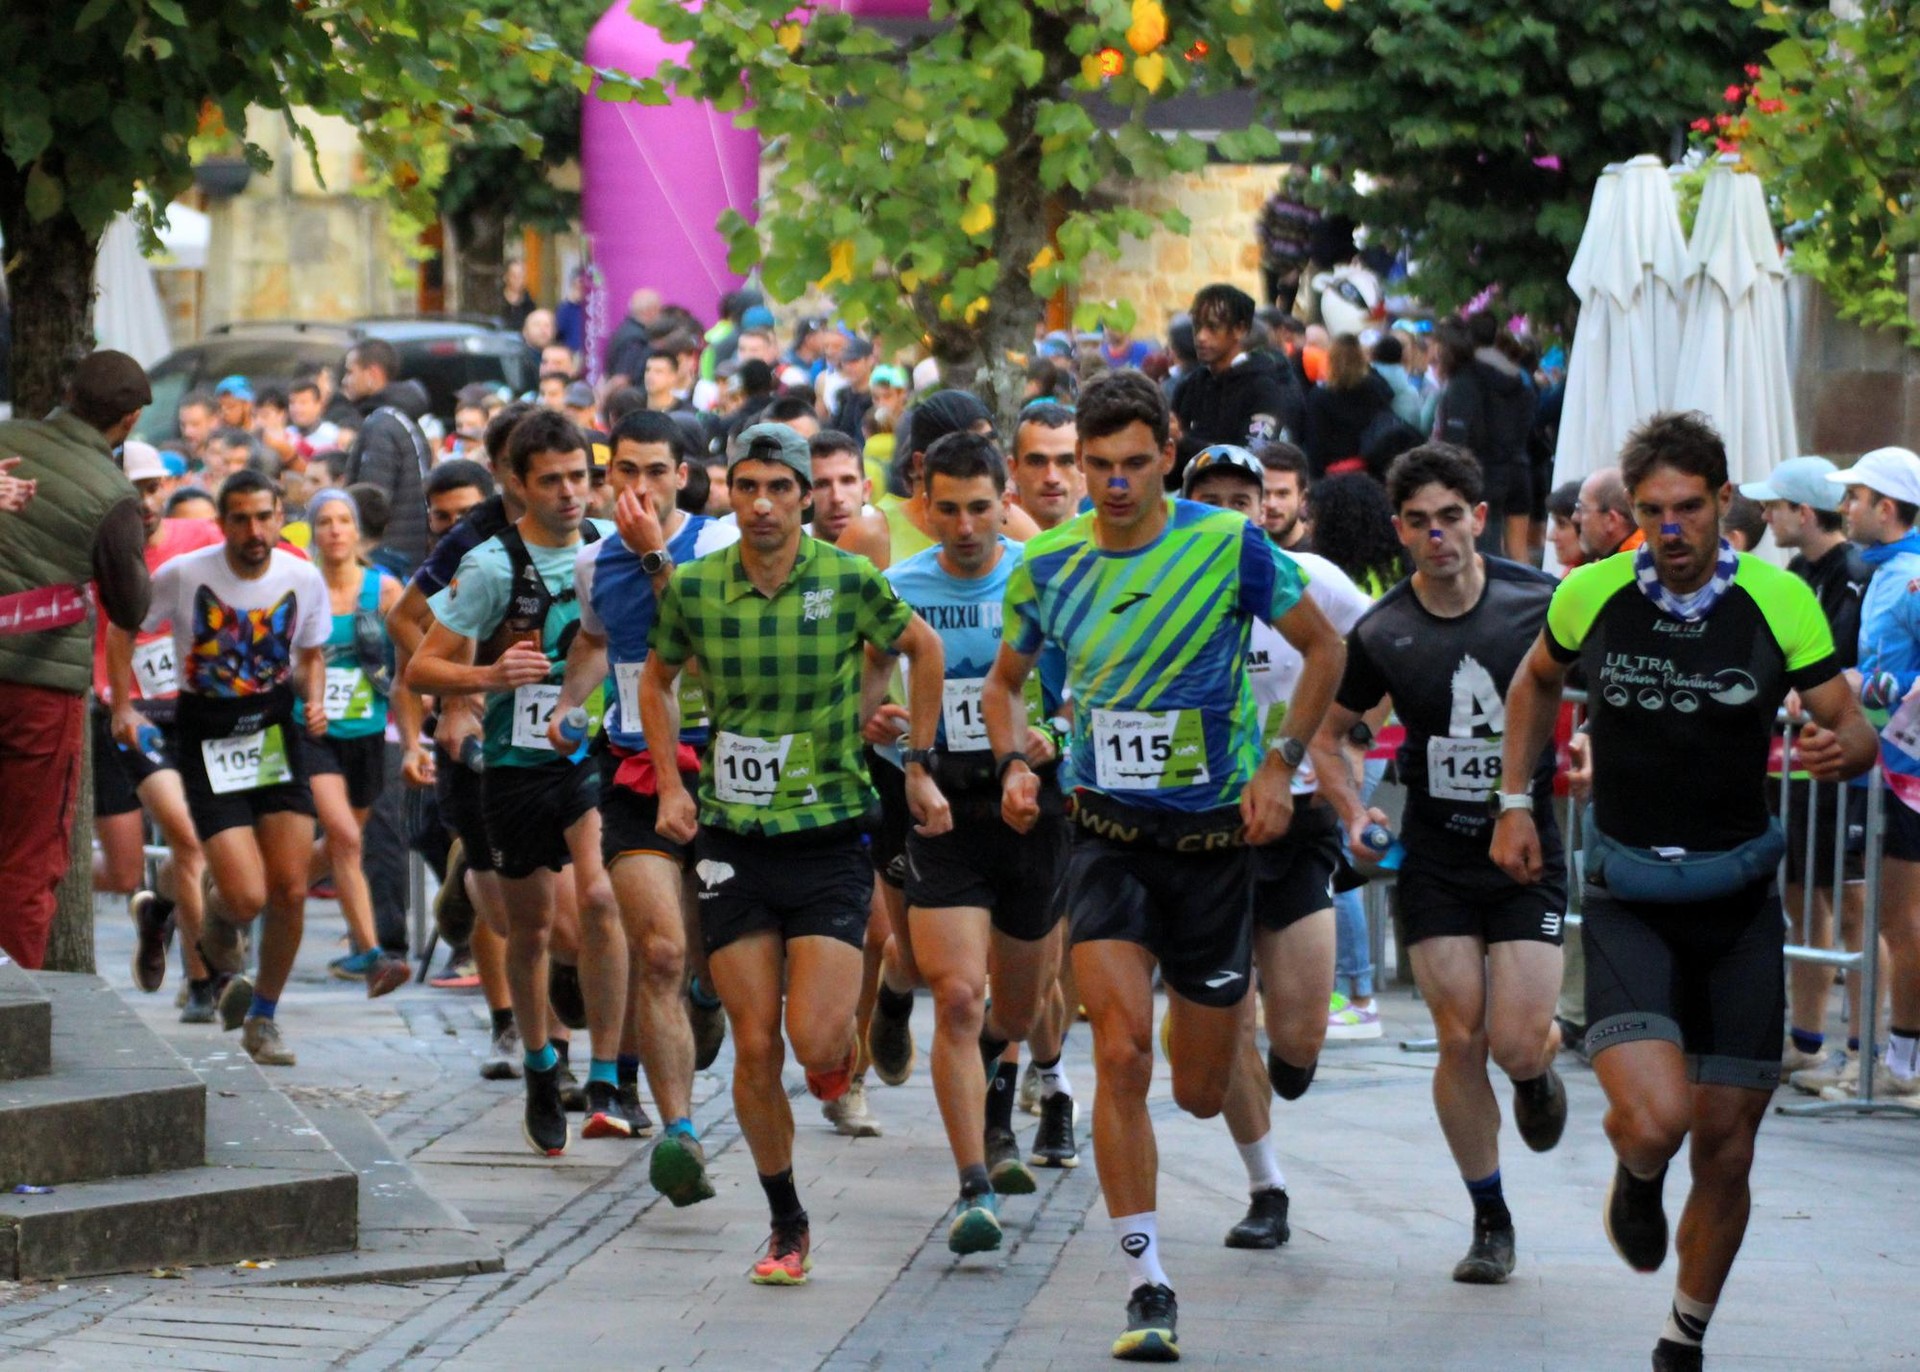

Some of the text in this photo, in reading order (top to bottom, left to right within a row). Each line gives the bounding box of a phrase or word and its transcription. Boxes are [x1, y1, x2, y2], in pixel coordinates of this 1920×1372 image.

[1606, 652, 1674, 673] ULTRA
[214, 747, 262, 772] 105
[1107, 734, 1172, 762] 115
[723, 755, 780, 782] 101
[1441, 755, 1503, 779] 148
